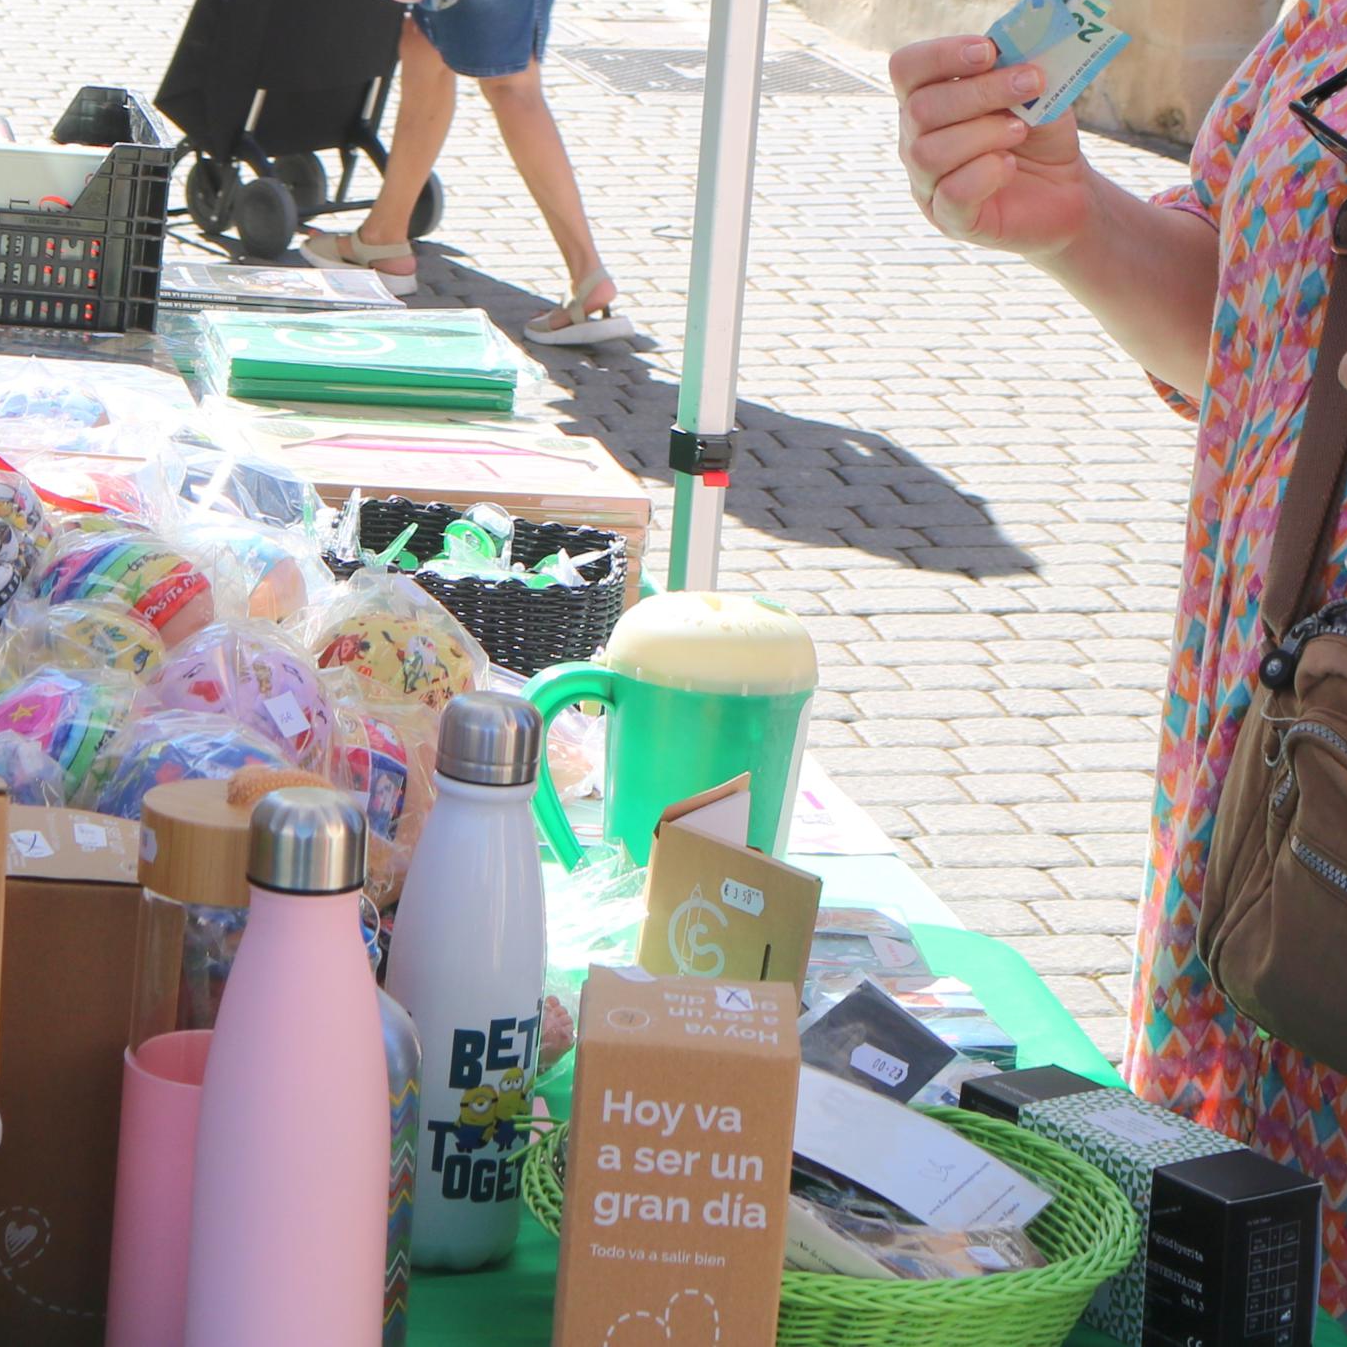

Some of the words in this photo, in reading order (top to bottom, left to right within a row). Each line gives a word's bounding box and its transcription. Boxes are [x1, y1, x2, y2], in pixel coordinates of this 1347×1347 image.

[668, 1006, 704, 1019] un
[684, 1022, 717, 1035] va
[723, 1024, 779, 1045] Hoy
[449, 1016, 542, 1089] BET
[603, 1089, 686, 1137] Hoy
[695, 1103, 742, 1133] va
[597, 1143, 622, 1172] a
[634, 1146, 700, 1176] ser
[712, 1153, 763, 1181] un
[593, 1190, 691, 1226] gran
[703, 1192, 767, 1229] día
[590, 1242, 626, 1258] Todo
[628, 1248, 646, 1260] va
[648, 1251, 658, 1263] a
[662, 1249, 692, 1264] salir
[694, 1251, 726, 1267] bien
